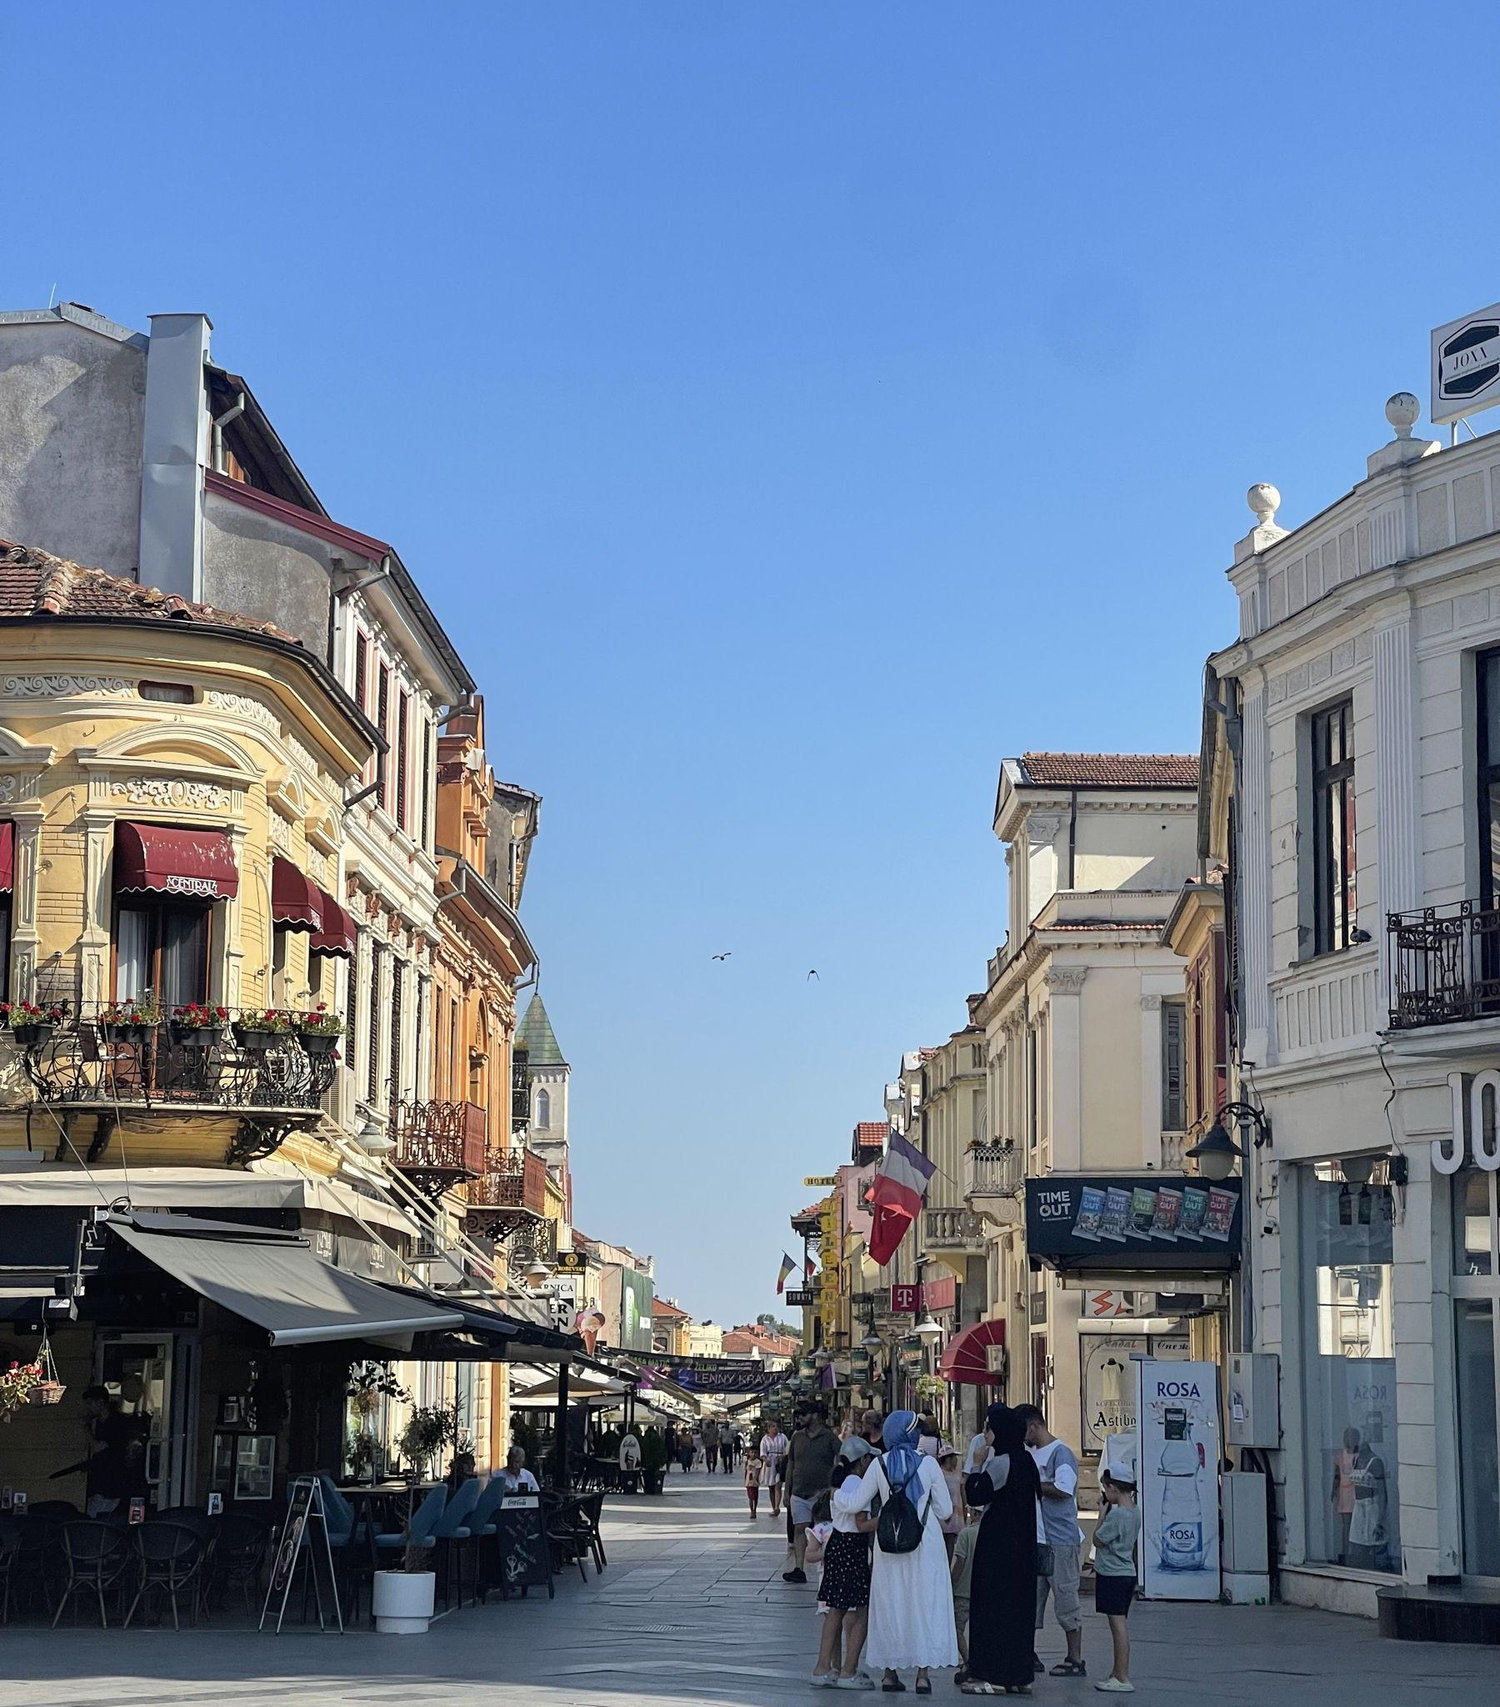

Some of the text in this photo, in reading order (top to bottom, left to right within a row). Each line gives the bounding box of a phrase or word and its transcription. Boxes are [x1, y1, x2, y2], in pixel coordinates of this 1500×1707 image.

[170, 877, 214, 892] CENTRAL
[1037, 1190, 1071, 1204] TIME
[1039, 1203, 1071, 1217] OUT
[1083, 1201, 1100, 1209] OUT
[1108, 1201, 1126, 1211] OUT
[1134, 1202, 1152, 1211] OUT
[1160, 1202, 1177, 1210] OUT
[1185, 1202, 1203, 1210] OUT
[1210, 1202, 1227, 1210] OUT
[897, 1289, 913, 1308] T
[695, 1372, 735, 1384] LENNY
[1157, 1382, 1201, 1397] ROSA
[1169, 1529, 1195, 1541] ROSA
